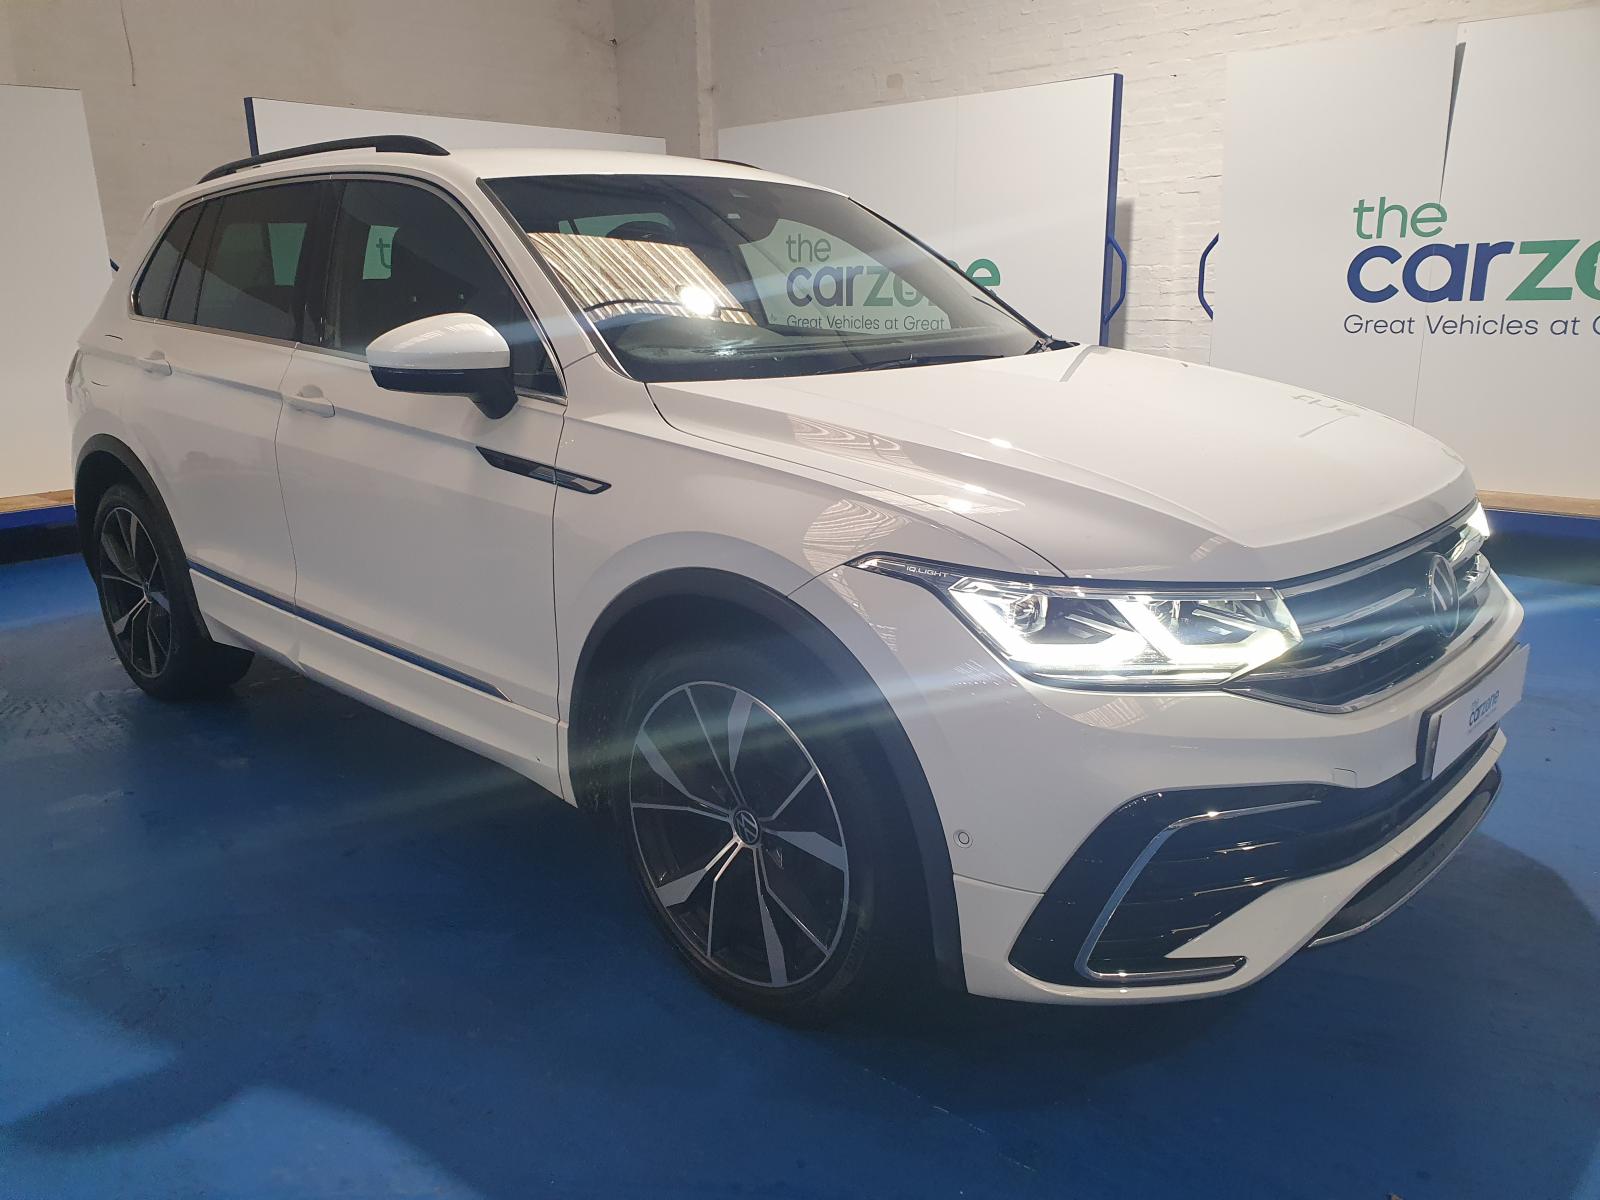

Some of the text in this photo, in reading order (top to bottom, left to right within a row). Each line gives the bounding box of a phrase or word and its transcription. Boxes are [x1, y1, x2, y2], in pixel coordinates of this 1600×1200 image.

[1353, 196, 1448, 240] the
[786, 233, 831, 263] the
[786, 314, 945, 331] Great Vehicles at Great
[1343, 314, 1416, 335] Great
[1426, 313, 1538, 336] Vehicles
[1550, 316, 1581, 336] at
[906, 565, 950, 578] IQ.LIGHT
